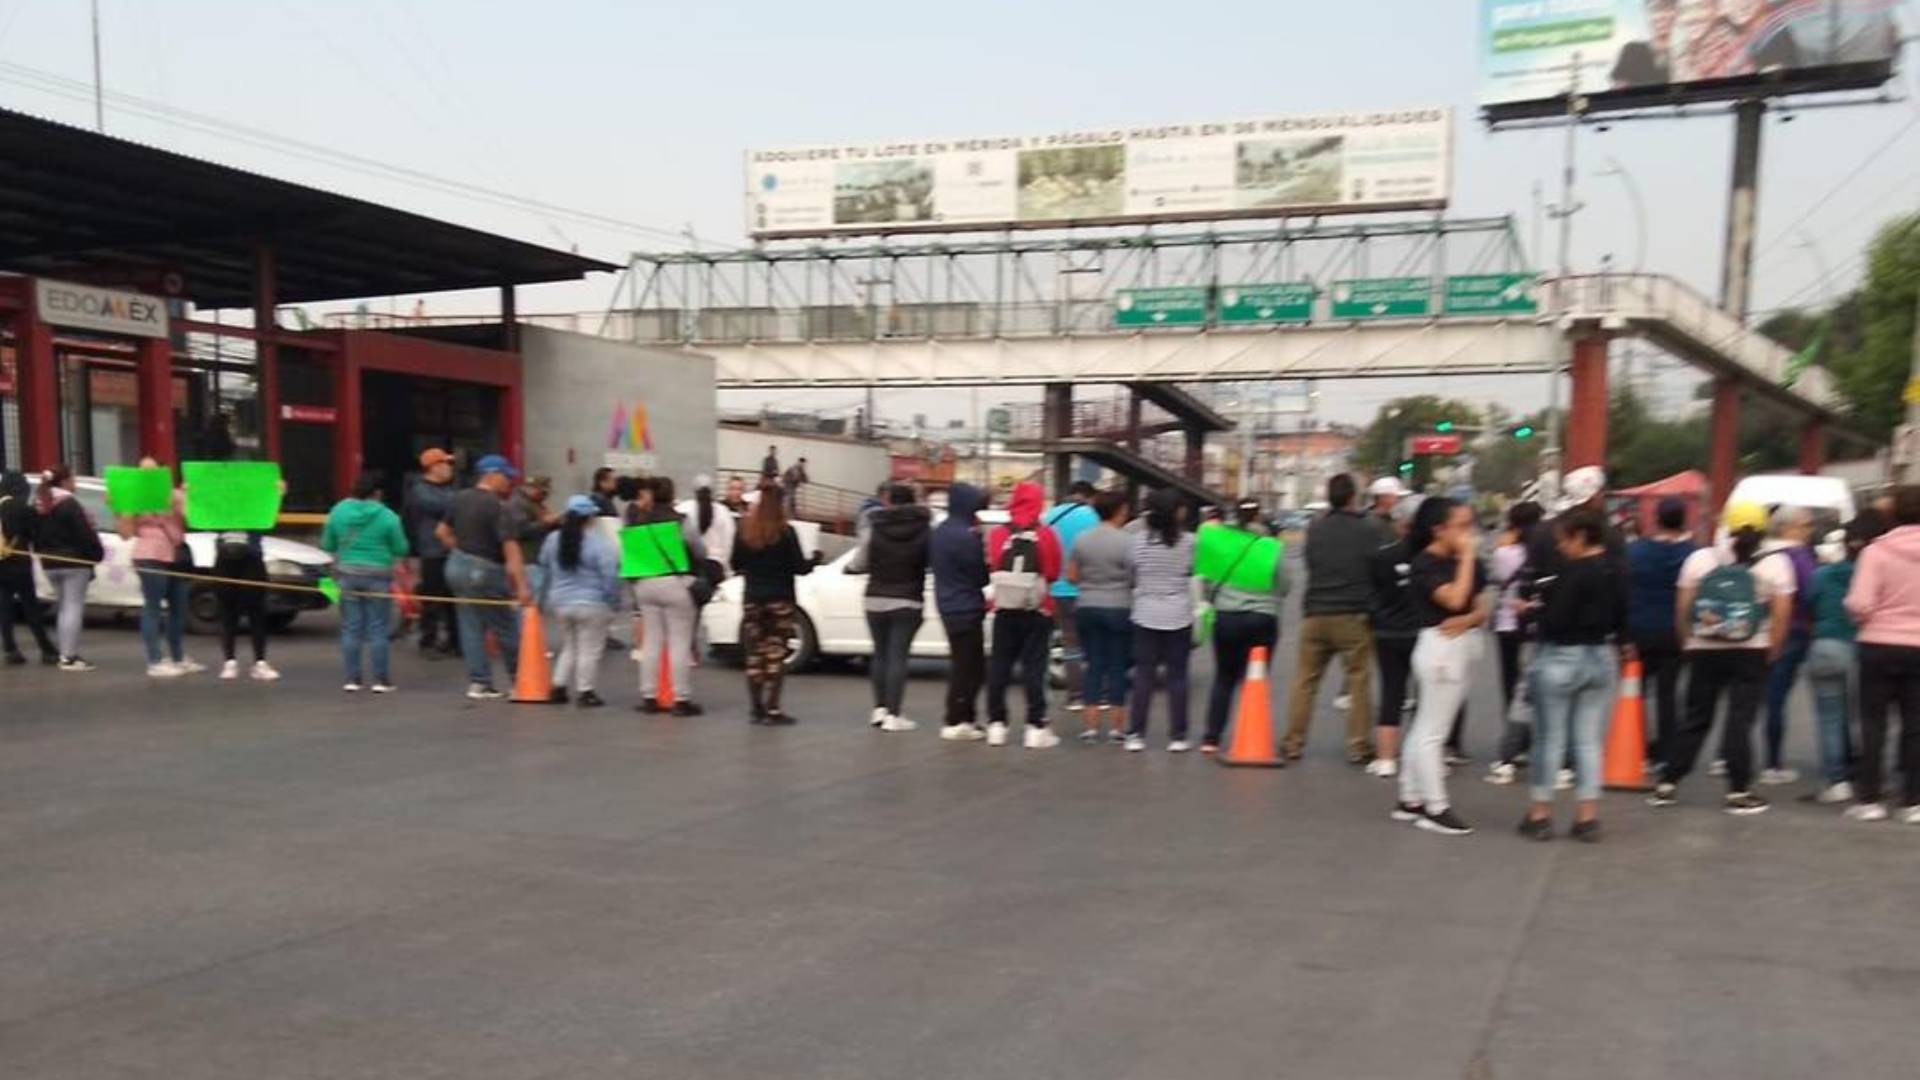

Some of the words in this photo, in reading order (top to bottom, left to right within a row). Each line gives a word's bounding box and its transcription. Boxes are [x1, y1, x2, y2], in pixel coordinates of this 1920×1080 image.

[754, 148, 839, 162] ADQUIERE
[845, 147, 868, 159] TU
[874, 144, 919, 157] LOTE
[925, 142, 947, 155] EN
[1130, 124, 1191, 141] HASTA
[1202, 123, 1226, 136] EN
[1263, 110, 1442, 132] MENSUALIDADES
